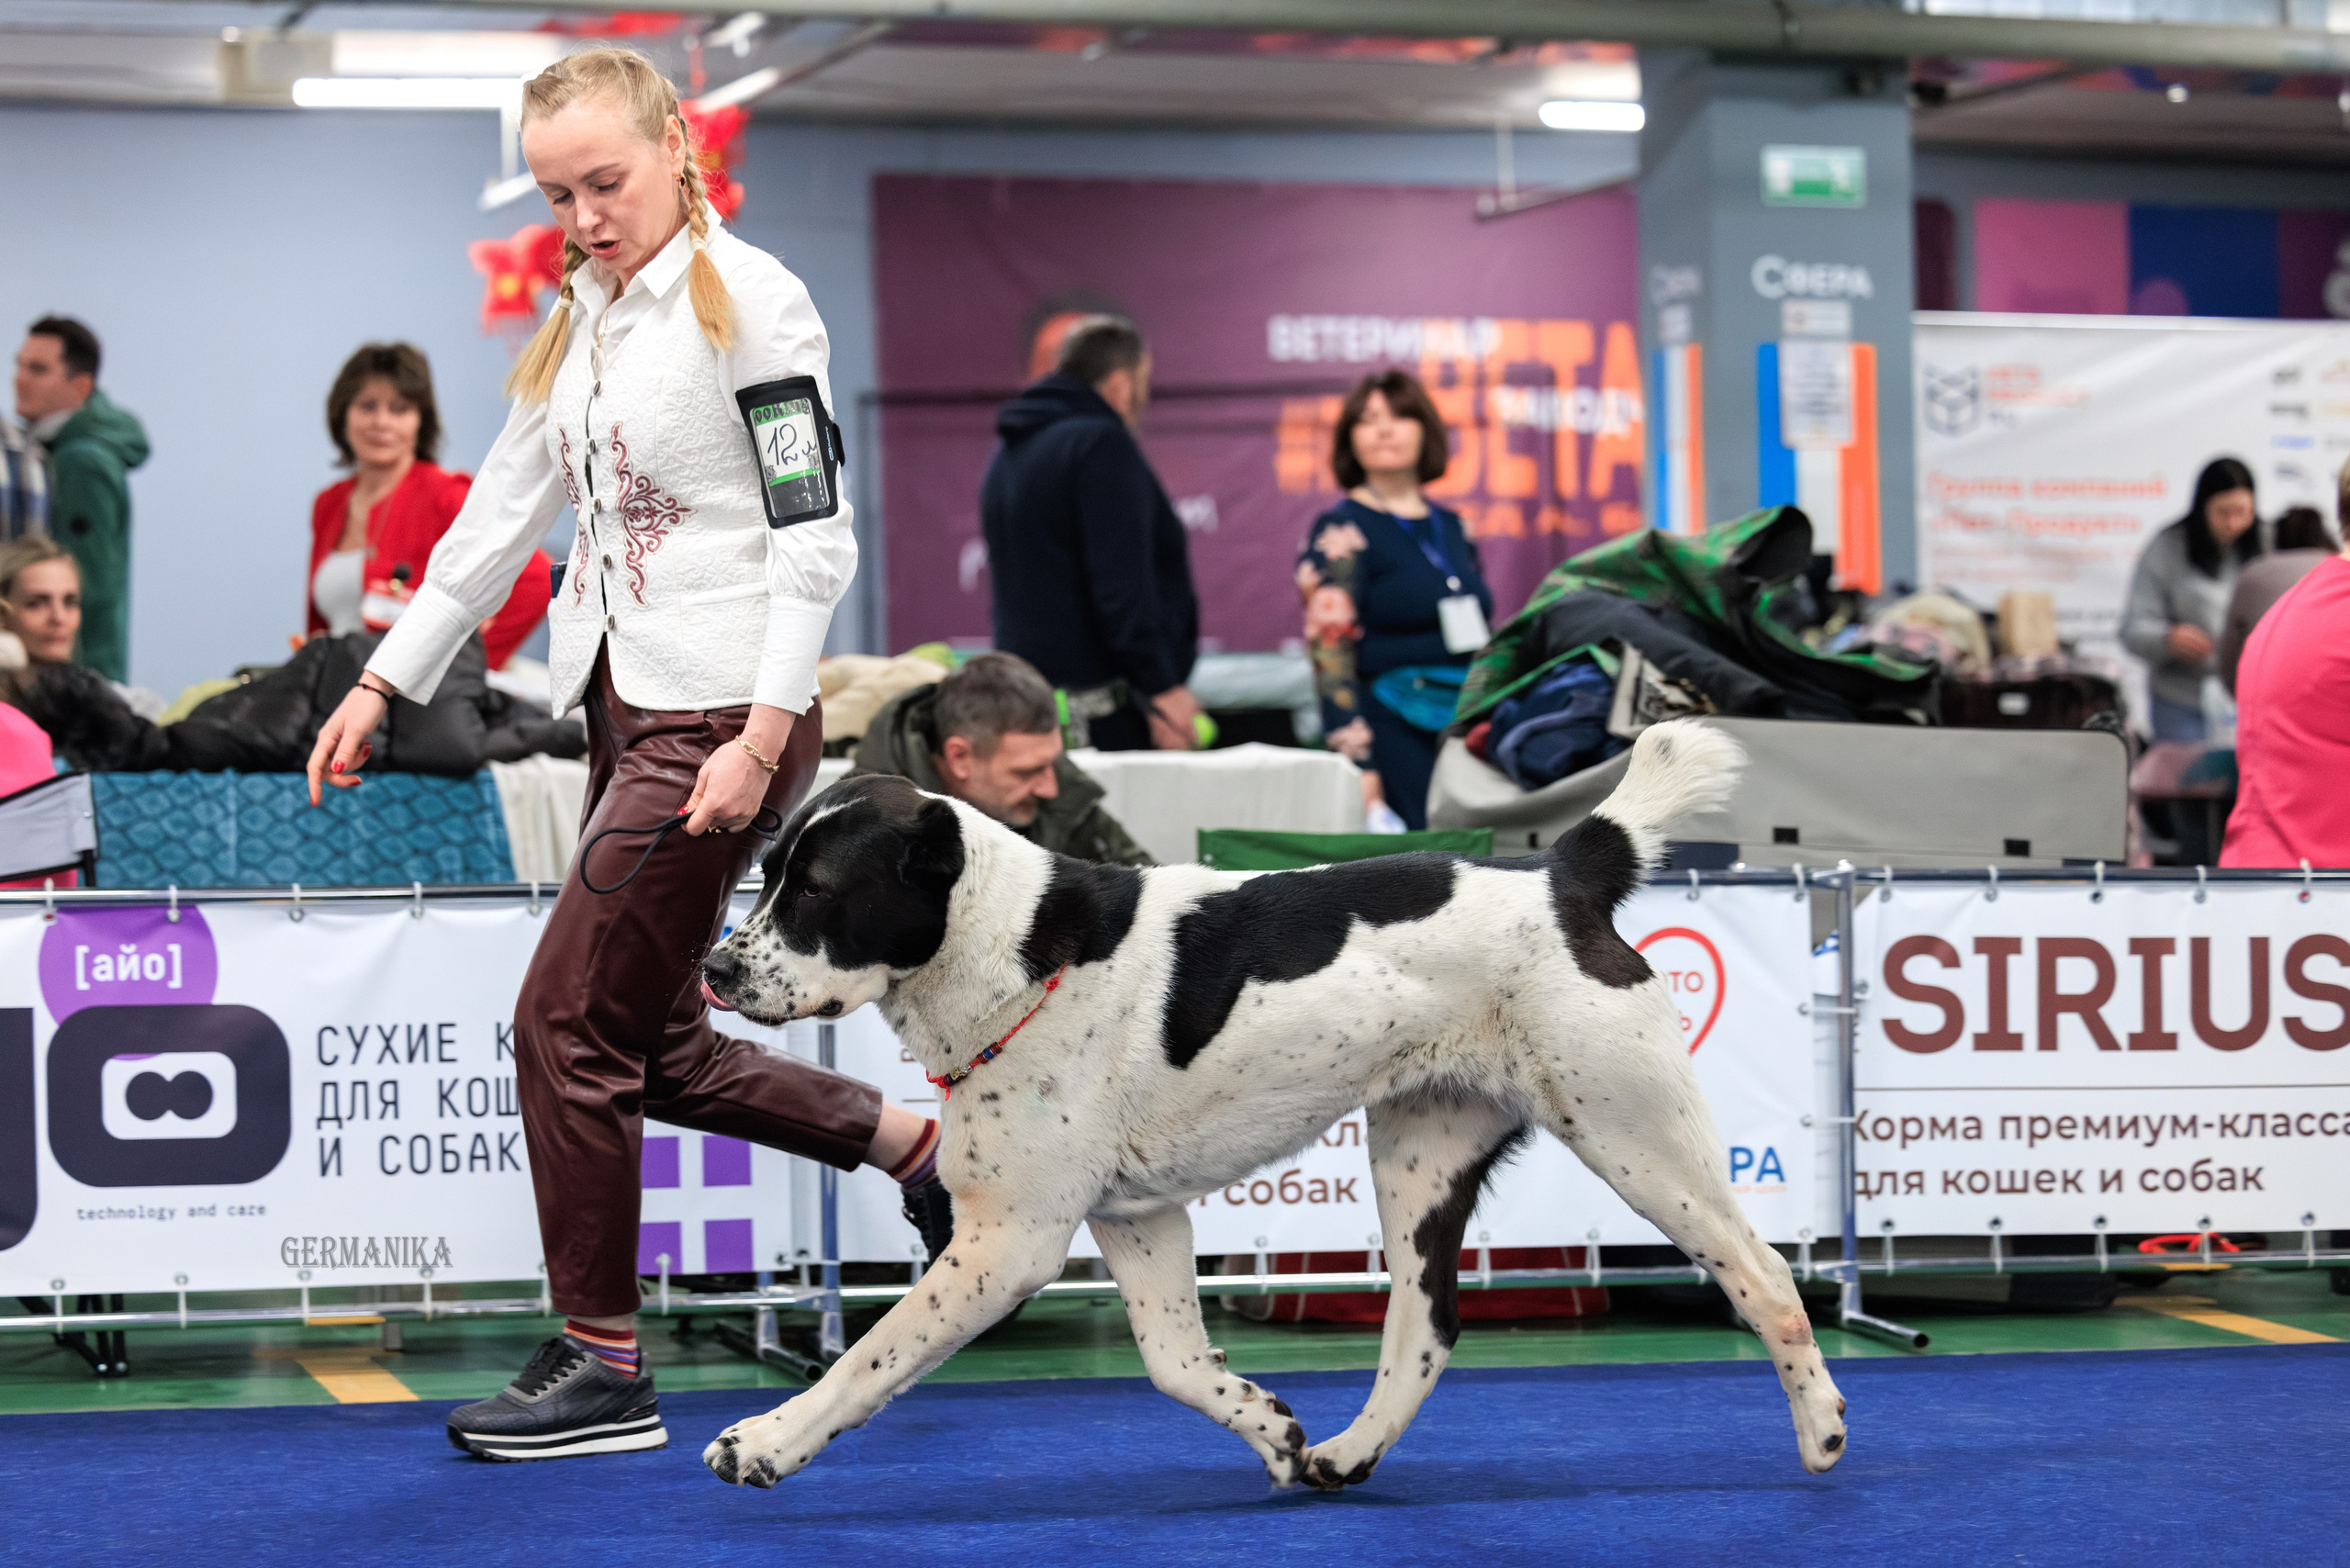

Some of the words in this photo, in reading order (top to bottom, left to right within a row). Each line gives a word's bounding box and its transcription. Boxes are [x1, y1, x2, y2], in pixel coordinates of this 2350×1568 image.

[767, 423, 798, 465] 12
[1882, 934, 2350, 1054] SIRIUS
[318, 1024, 457, 1066] СУХИЕ
[317, 1080, 399, 1130] ДЛЯ
[319, 1137, 341, 1177] И
[379, 1132, 520, 1176] СОБАК
[1224, 1169, 1358, 1205] собак
[1942, 1168, 2084, 1193] кошек
[2098, 1168, 2123, 1193] и
[2139, 1159, 2265, 1193] собак
[76, 1204, 176, 1222] technology
[187, 1204, 218, 1218] and
[228, 1204, 266, 1217] care
